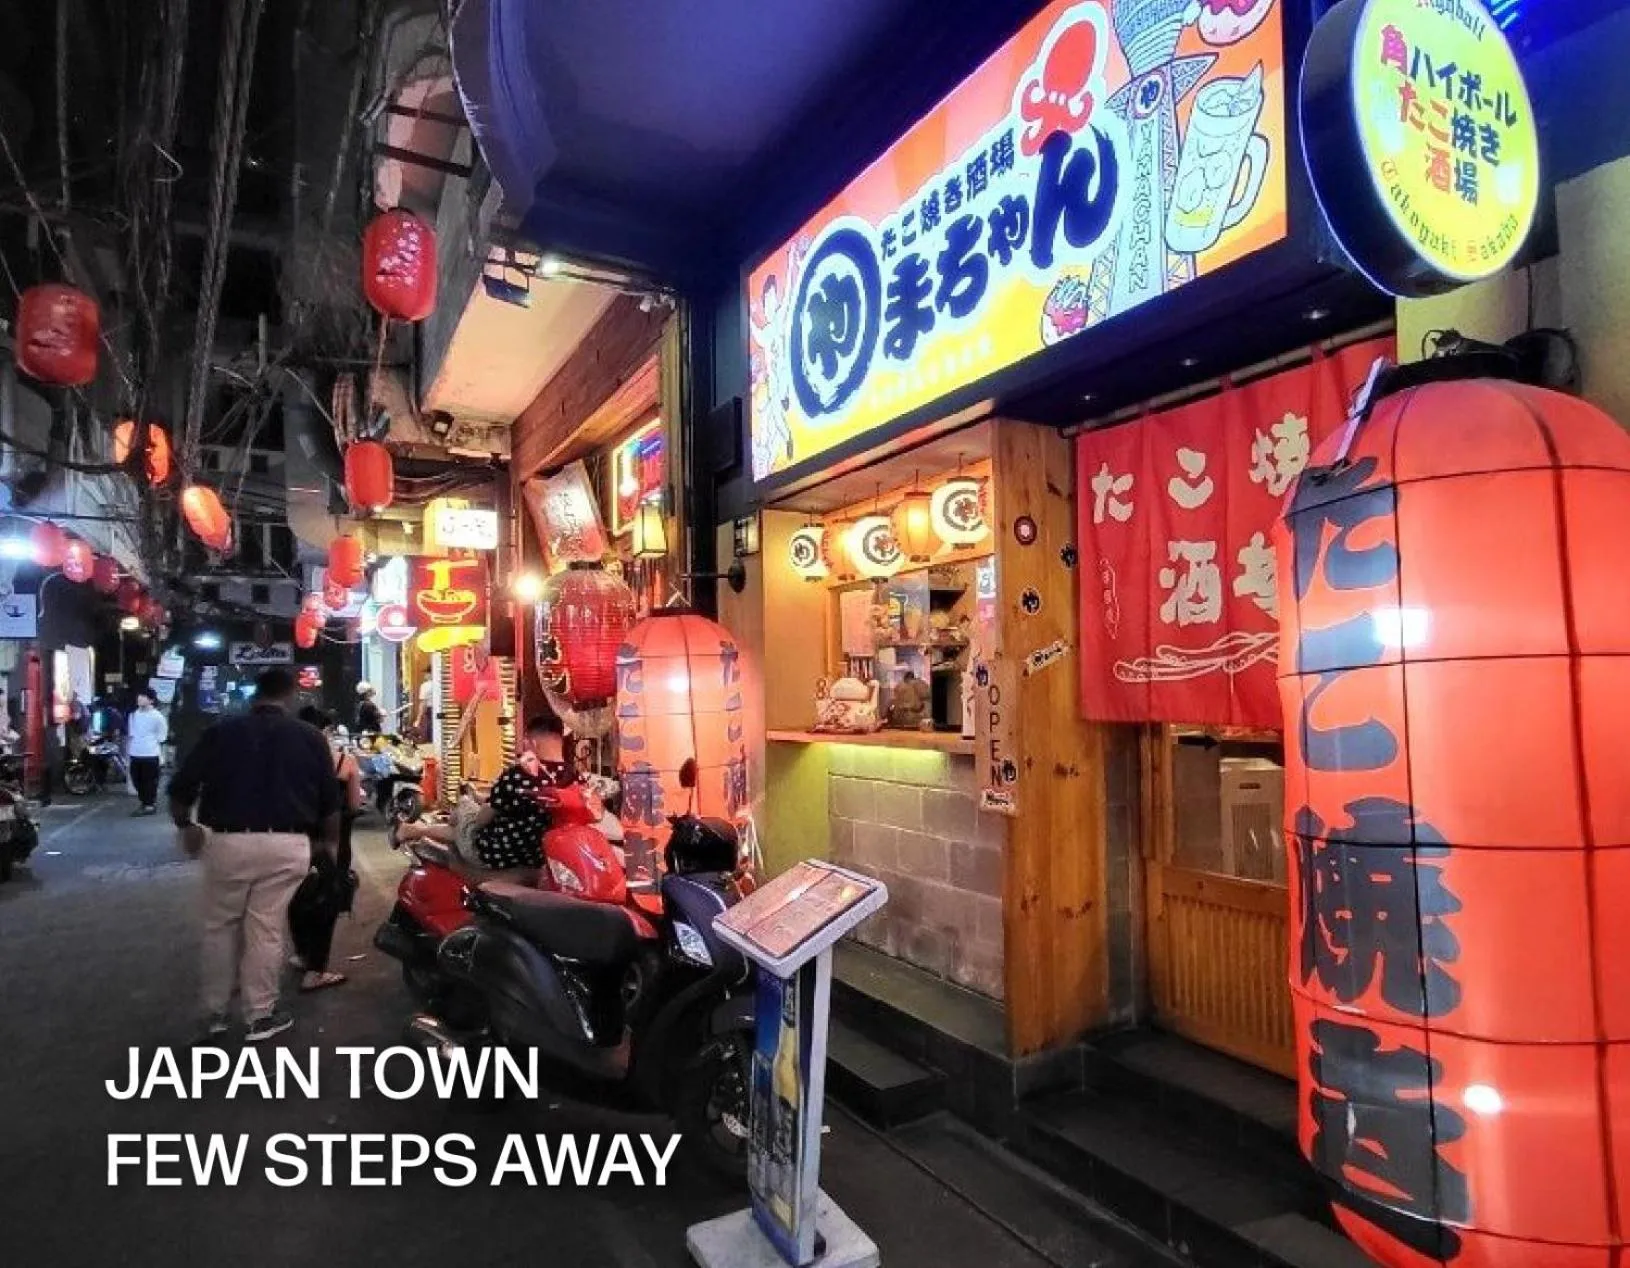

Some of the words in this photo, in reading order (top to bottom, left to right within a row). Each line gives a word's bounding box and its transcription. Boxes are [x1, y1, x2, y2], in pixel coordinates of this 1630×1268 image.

[1398, 80, 1500, 168] たこ焼き
[880, 127, 1015, 262] たこ焼き酒場
[1425, 142, 1478, 206] 酒場
[988, 684, 1002, 787] OPEN
